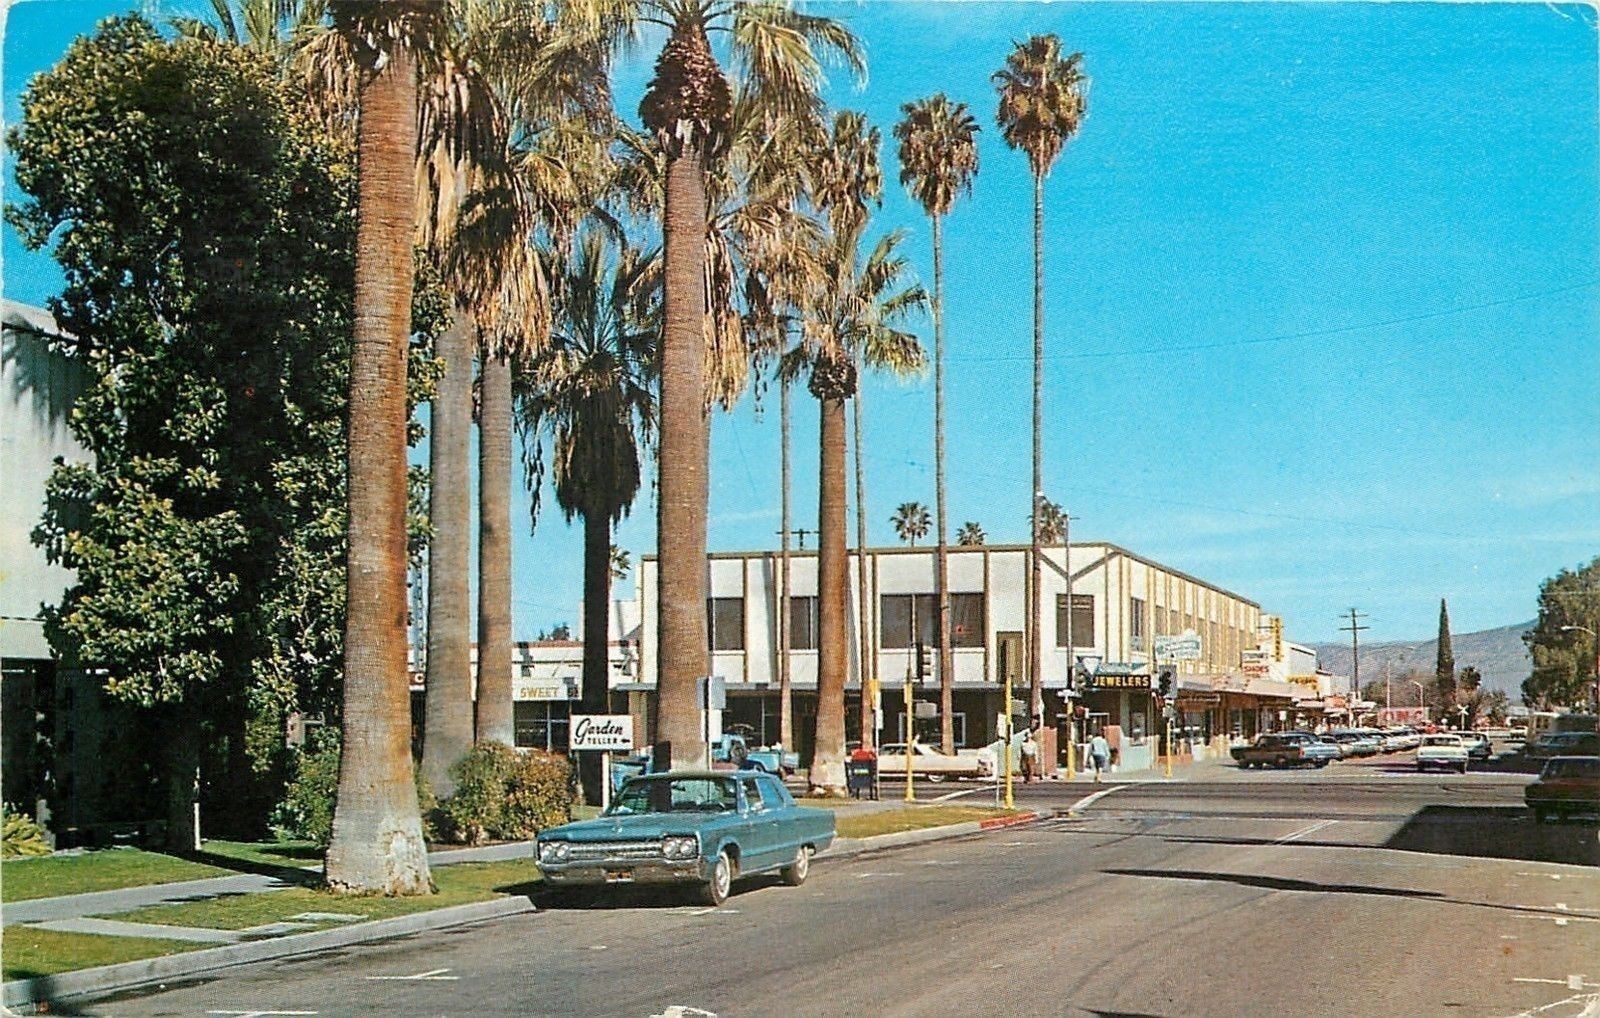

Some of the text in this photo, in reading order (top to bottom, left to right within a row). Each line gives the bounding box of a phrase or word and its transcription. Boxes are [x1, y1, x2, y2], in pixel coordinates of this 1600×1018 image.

[1092, 676, 1150, 687] JEWELERS
[520, 686, 559, 698] SWEET
[574, 717, 624, 745] Garden
